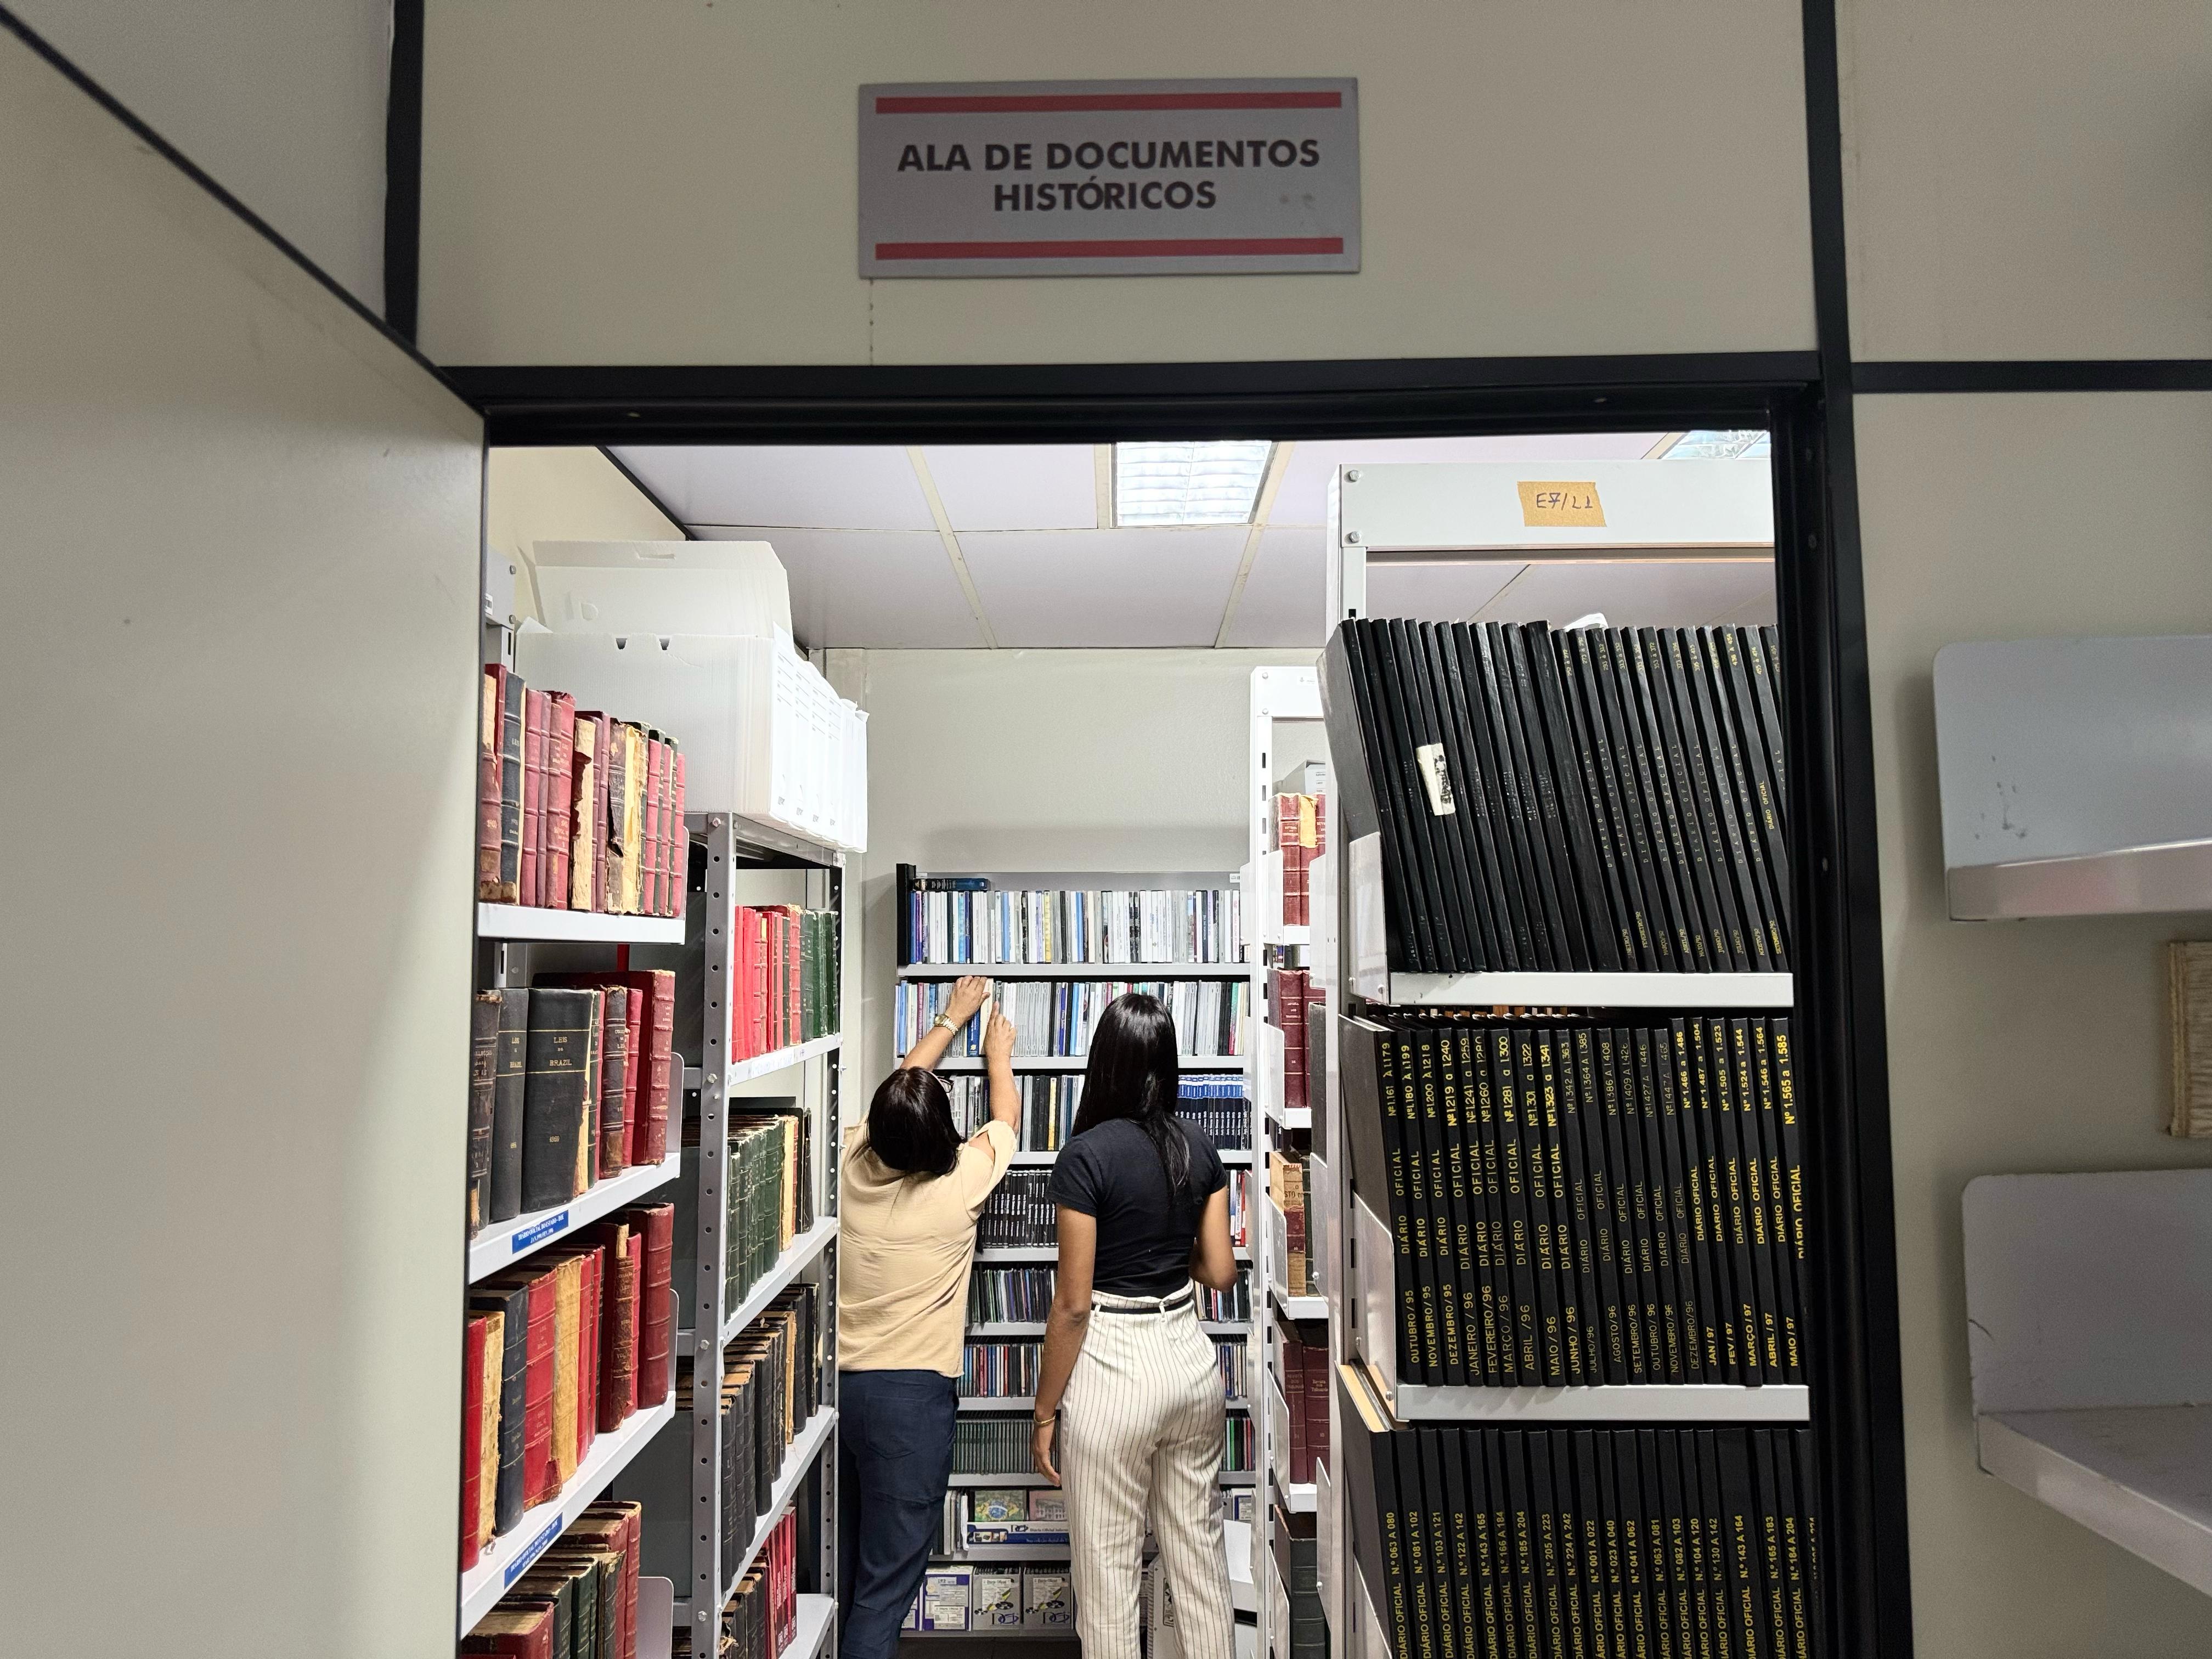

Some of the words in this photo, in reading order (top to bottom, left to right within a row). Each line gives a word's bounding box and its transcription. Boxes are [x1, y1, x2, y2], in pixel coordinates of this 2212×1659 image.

[898, 144, 971, 172] ALA
[985, 143, 1031, 171] DE
[1047, 139, 1320, 170] DOCUMENTOS
[994, 176, 1216, 212] HISTÓRICOS
[1759, 781, 1769, 804] OFICIAL
[1674, 1030, 1685, 1056] 1.486
[1712, 1024, 1724, 1052] 1.523
[1734, 1029, 1746, 1056] 1.544
[1775, 1035, 1790, 1064] 1.585
[1680, 1059, 1686, 1067] a
[1717, 1057, 1724, 1066] a
[1738, 1060, 1746, 1069] a
[1782, 1069, 1791, 1078] a
[1679, 1070, 1689, 1096] 1.466
[1718, 1068, 1728, 1096] 1.505
[1738, 1069, 1750, 1098] 1.524
[1780, 1078, 1793, 1110] 1.565
[1392, 1148, 1404, 1196] OFICIAL
[1411, 1152, 1422, 1199] OFICIAL
[1431, 1148, 1443, 1197] OFICIAL
[1469, 1141, 1483, 1194] OFICIAL
[1550, 1141, 1565, 1198] OFICIAL
[1728, 1157, 1739, 1200] OFICIAL
[1747, 1159, 1760, 1201] OFICIAL
[1593, 1172, 1605, 1209] OFICIAL
[1690, 1165, 1700, 1206] OFICIAL
[1790, 1165, 1803, 1214] OFICIAL
[1616, 1183, 1627, 1222] OFICIAL
[1397, 1216, 1410, 1254] DIÁRIO
[1416, 1218, 1427, 1257] DIÁRIO
[1436, 1217, 1448, 1255] DIÁRIO
[1695, 1206, 1705, 1241] DIÁRIO
[1733, 1206, 1744, 1244] DIÁRIO
[1753, 1205, 1765, 1245] DIÁRIO
[1476, 1221, 1490, 1266] DIÁRIO
[1558, 1224, 1571, 1269] DIÁRIO
[1599, 1229, 1611, 1261] DIÁRIO
[1622, 1240, 1632, 1273] DIÁRIO
[1743, 1304, 1751, 1318] 97
[1765, 1313, 1773, 1327] 97
[1706, 1327, 1714, 1338] 97
[1746, 1323, 1757, 1366] MARÇO
[1708, 1345, 1717, 1366] JAN
[1767, 1333, 1778, 1367] ABRIL
[1386, 1512, 1396, 1530] 080
[1409, 1511, 1418, 1527] 102
[1432, 1512, 1442, 1527] 121
[1516, 1511, 1526, 1528] 204
[1690, 1519, 1700, 1535] 120
[1735, 1515, 1743, 1532] 164
[1389, 1542, 1398, 1558] 063
[1413, 1541, 1421, 1559] 081
[1435, 1540, 1443, 1557] 103
[1519, 1541, 1528, 1557] 185
[1736, 1534, 1745, 1542] A
[1737, 1544, 1747, 1561] 143
[1693, 1547, 1702, 1564] 104
[1393, 1583, 1404, 1623] OFICIAL
[1417, 1582, 1427, 1622] OFICIAL
[1439, 1581, 1450, 1621] OFICIAL
[1523, 1581, 1534, 1622] OFICIAL
[1697, 1591, 1707, 1629] OFICIAL
[1742, 1585, 1753, 1627] OFICIAL
[1397, 1625, 1408, 1659] DIÁRIO
[1420, 1624, 1431, 1659] DIÁRIO
[1442, 1623, 1454, 1658] DIÁRIO
[1526, 1624, 1537, 1659] DIÁRIO
